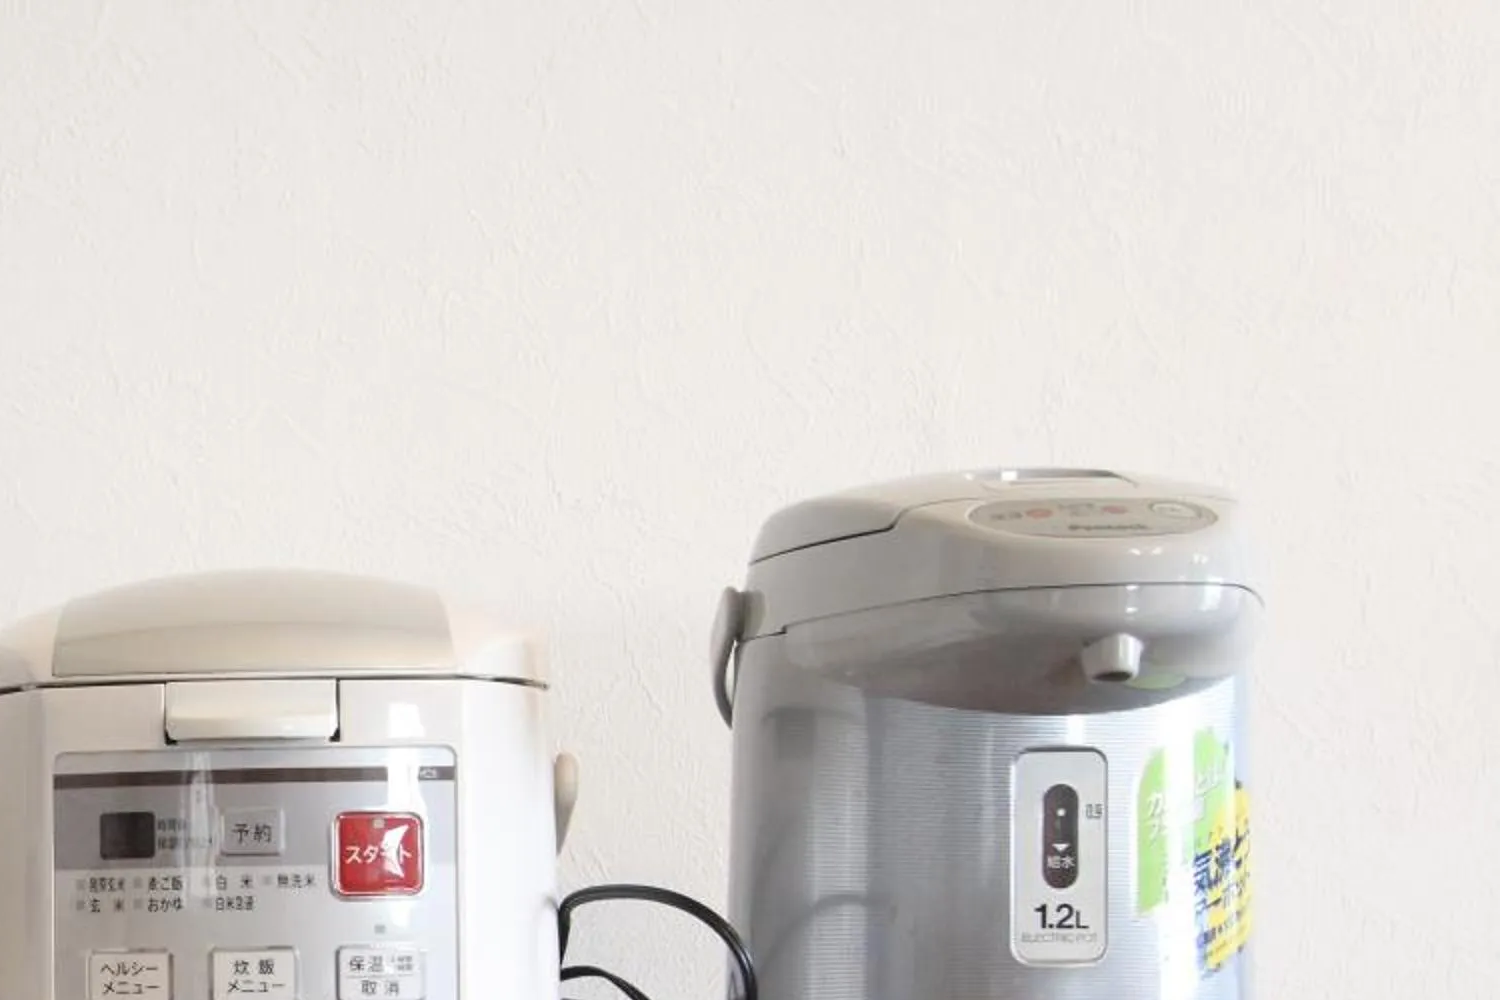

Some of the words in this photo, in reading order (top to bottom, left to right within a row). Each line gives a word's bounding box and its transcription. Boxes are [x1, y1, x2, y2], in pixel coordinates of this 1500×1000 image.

[232, 823, 272, 844] 予約
[1033, 903, 1090, 929] 1.2L
[100, 961, 158, 976] ヘルシー
[233, 959, 275, 976] 炊飯
[102, 981, 160, 995] メニュー
[227, 979, 285, 993] メニュー
